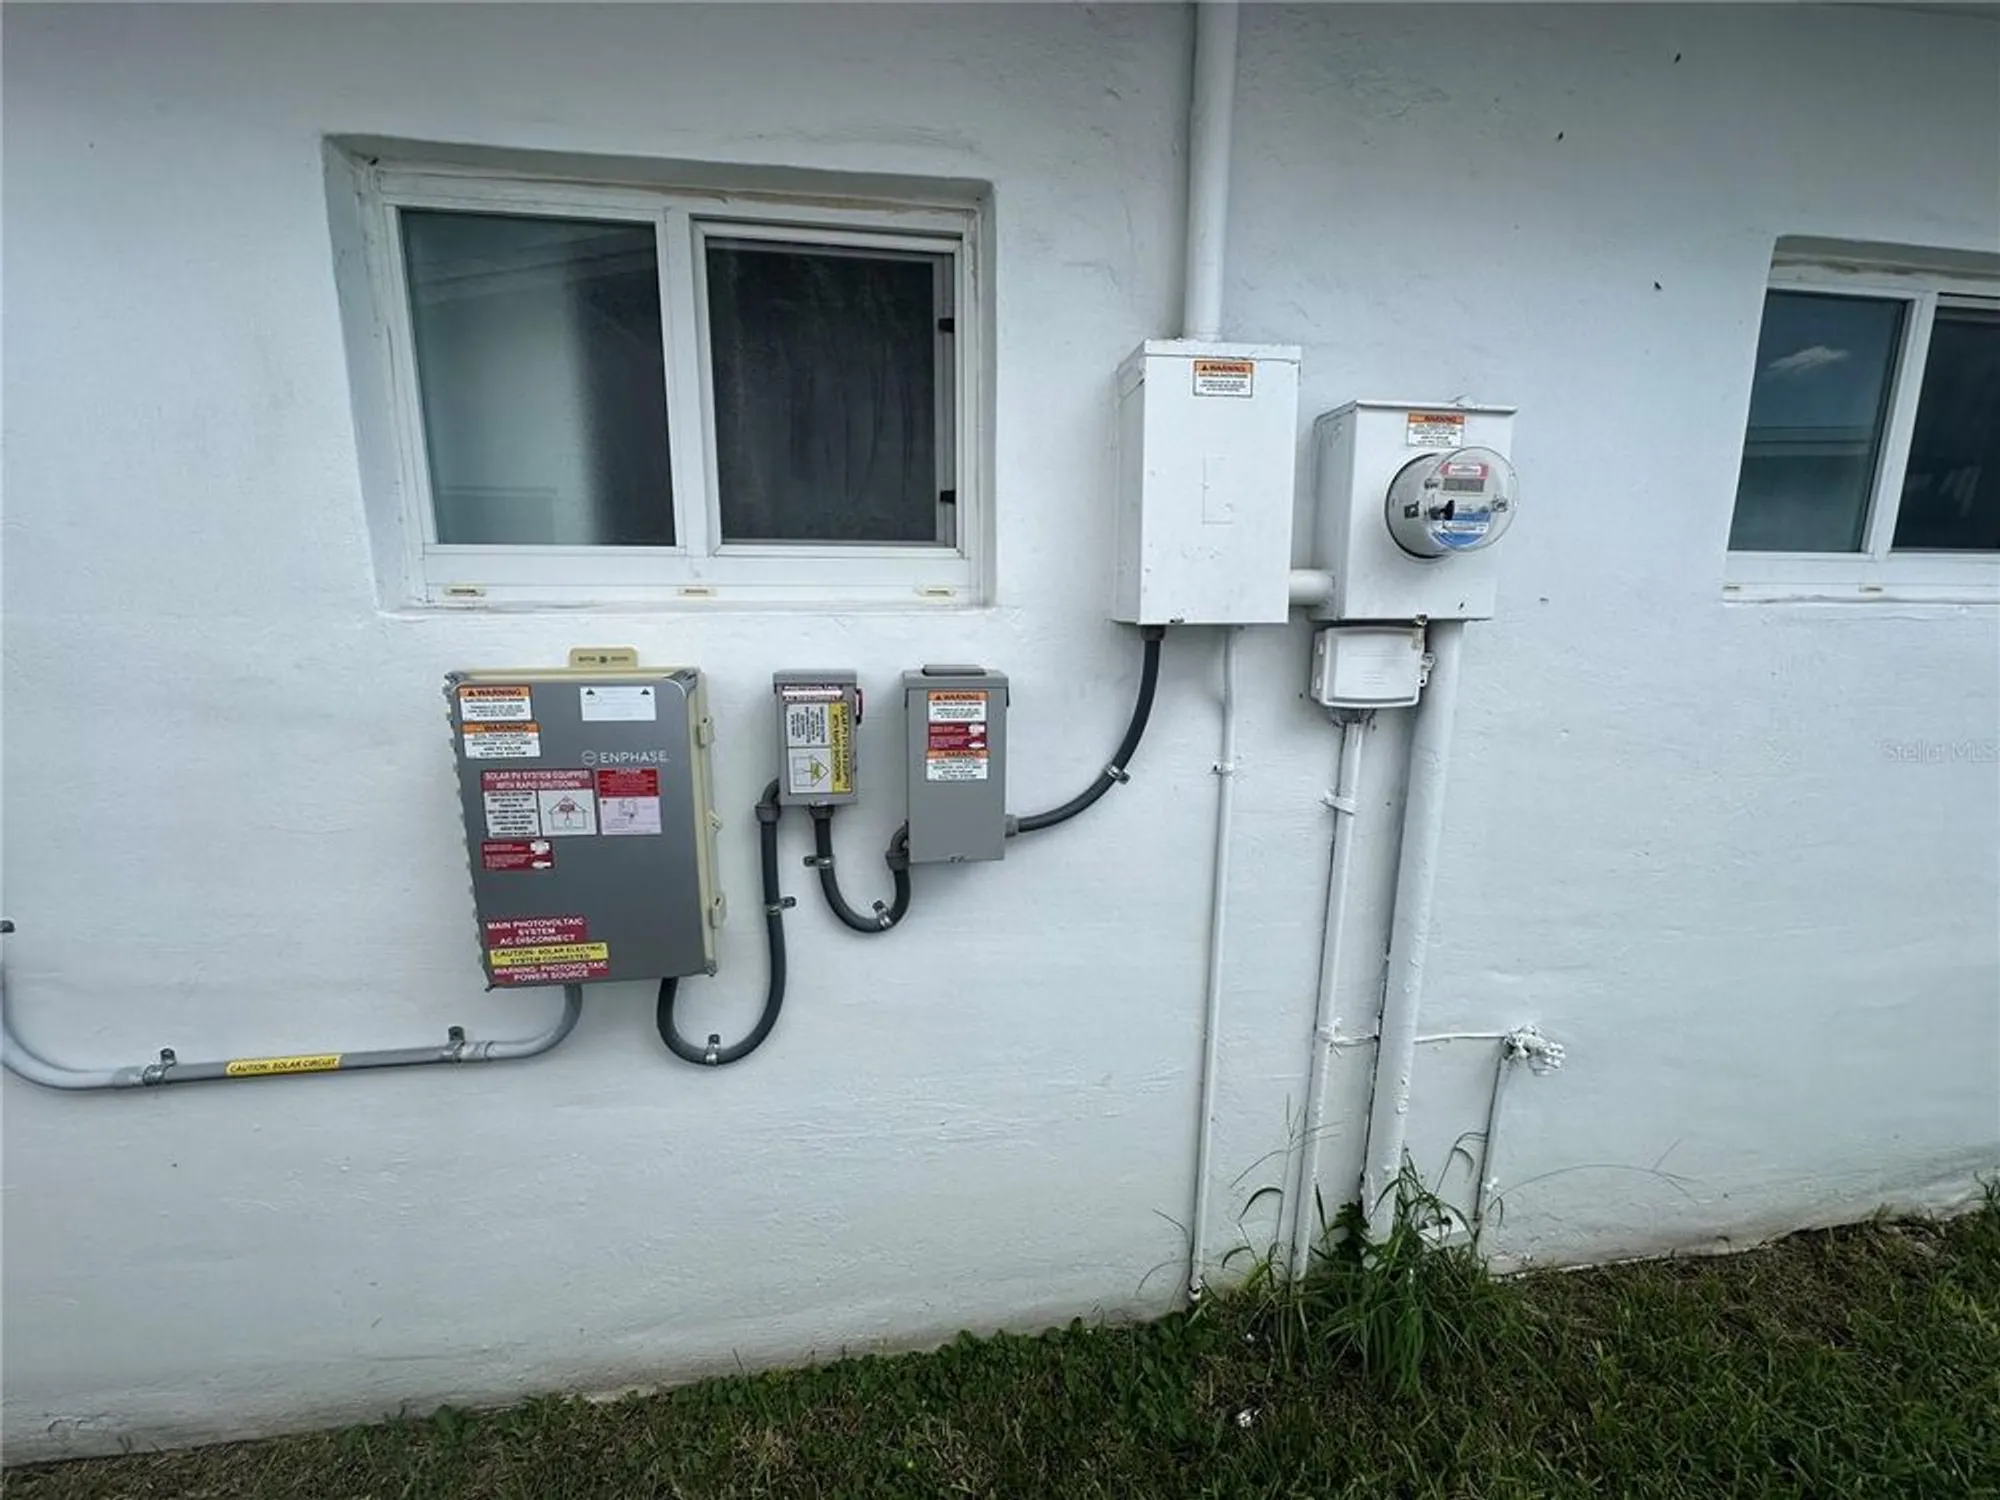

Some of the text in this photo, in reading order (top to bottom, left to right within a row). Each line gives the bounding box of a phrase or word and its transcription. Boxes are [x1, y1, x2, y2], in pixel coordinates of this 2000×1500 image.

[600, 750, 668, 764] ENPHASE
[484, 772, 509, 780] SOLAR
[487, 918, 583, 930] MAIN PHOTOVOLTAIC
[518, 927, 556, 936] SYSTEM
[500, 934, 576, 946] AC DISCONNECT
[538, 946, 565, 955] SOLAR
[566, 945, 605, 953] ELECTRIC
[541, 961, 608, 972] PHOTOVOLTAIC
[514, 969, 589, 981] POWER SOURCE
[272, 1061, 301, 1071] SOLAR
[303, 1058, 338, 1068] CIRCUIT
